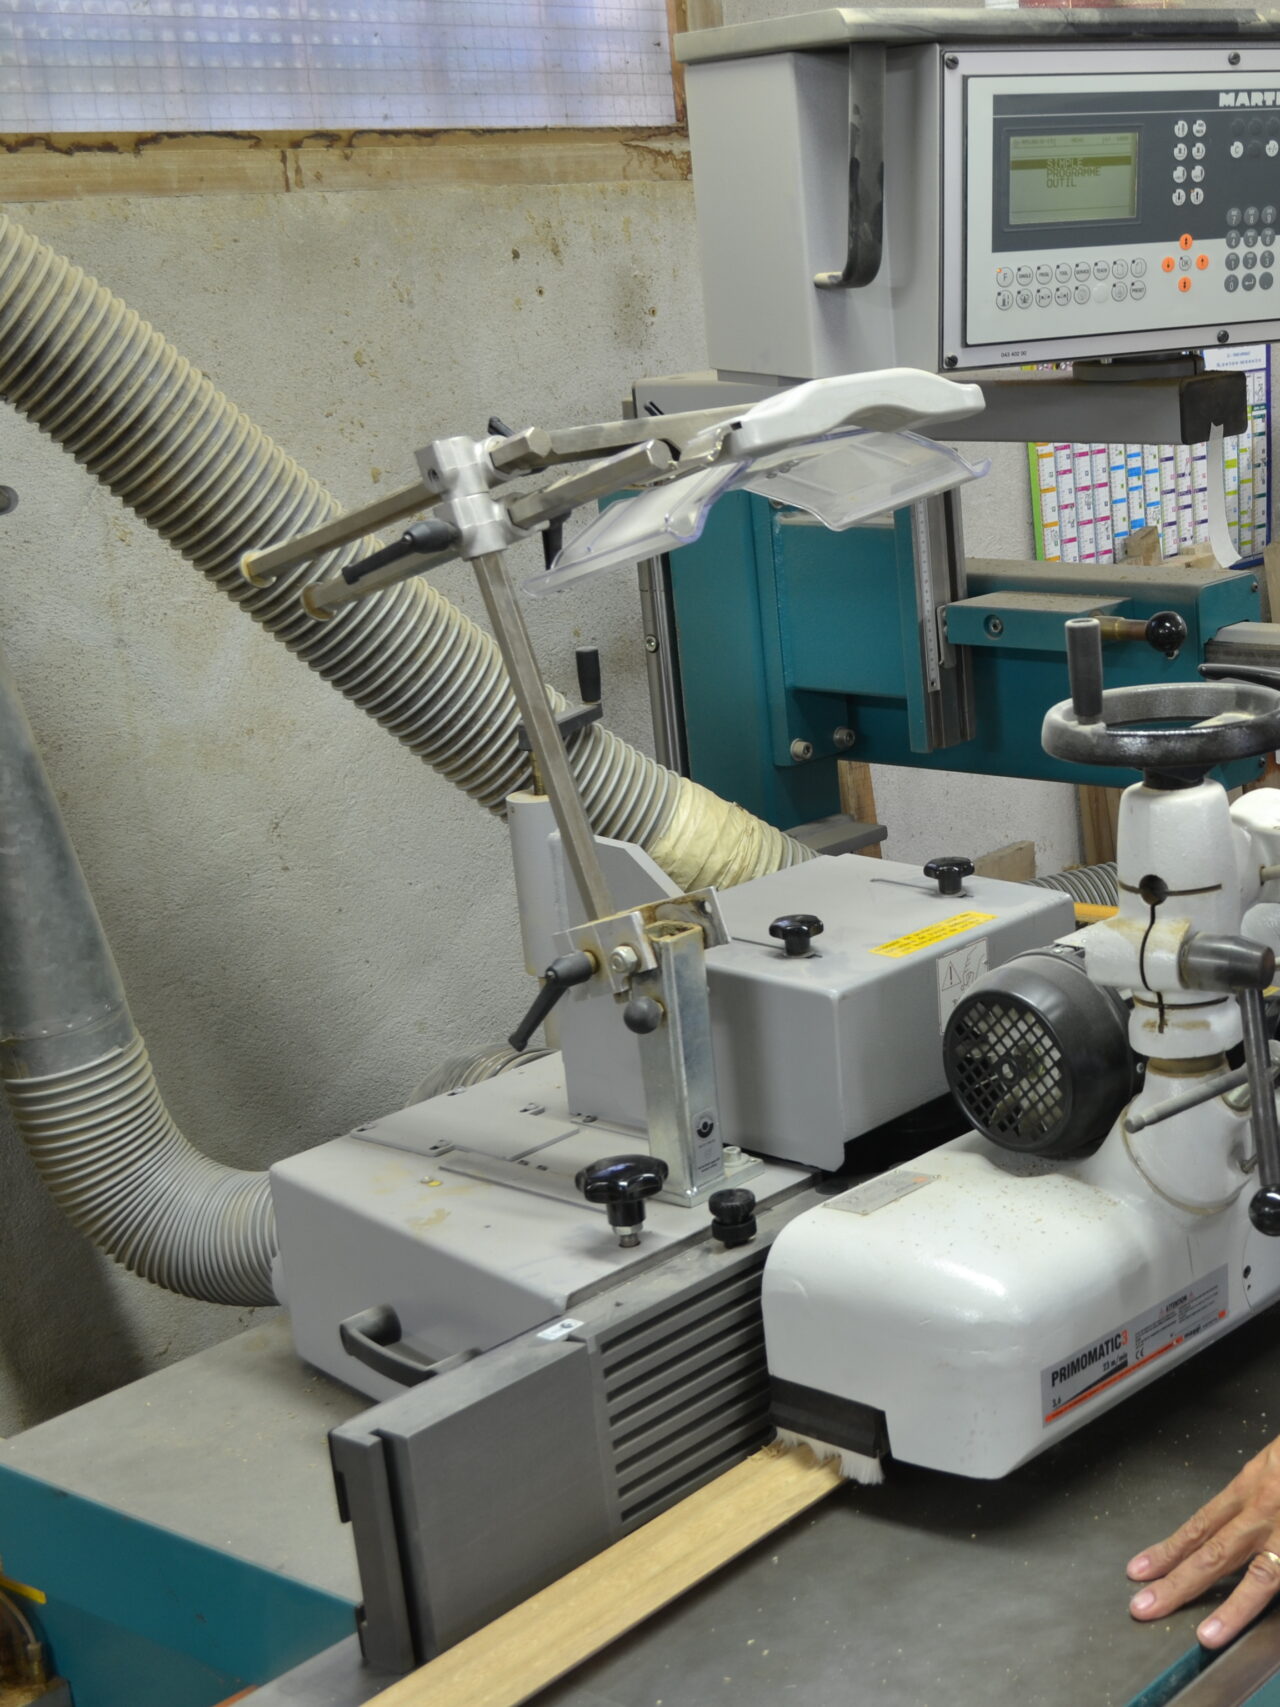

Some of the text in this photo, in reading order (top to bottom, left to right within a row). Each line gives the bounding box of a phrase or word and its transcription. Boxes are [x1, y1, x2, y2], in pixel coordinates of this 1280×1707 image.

[1047, 157, 1084, 168] SIMPLE
[1047, 166, 1101, 177] PROGRAMME
[1047, 177, 1077, 188] OUTIL
